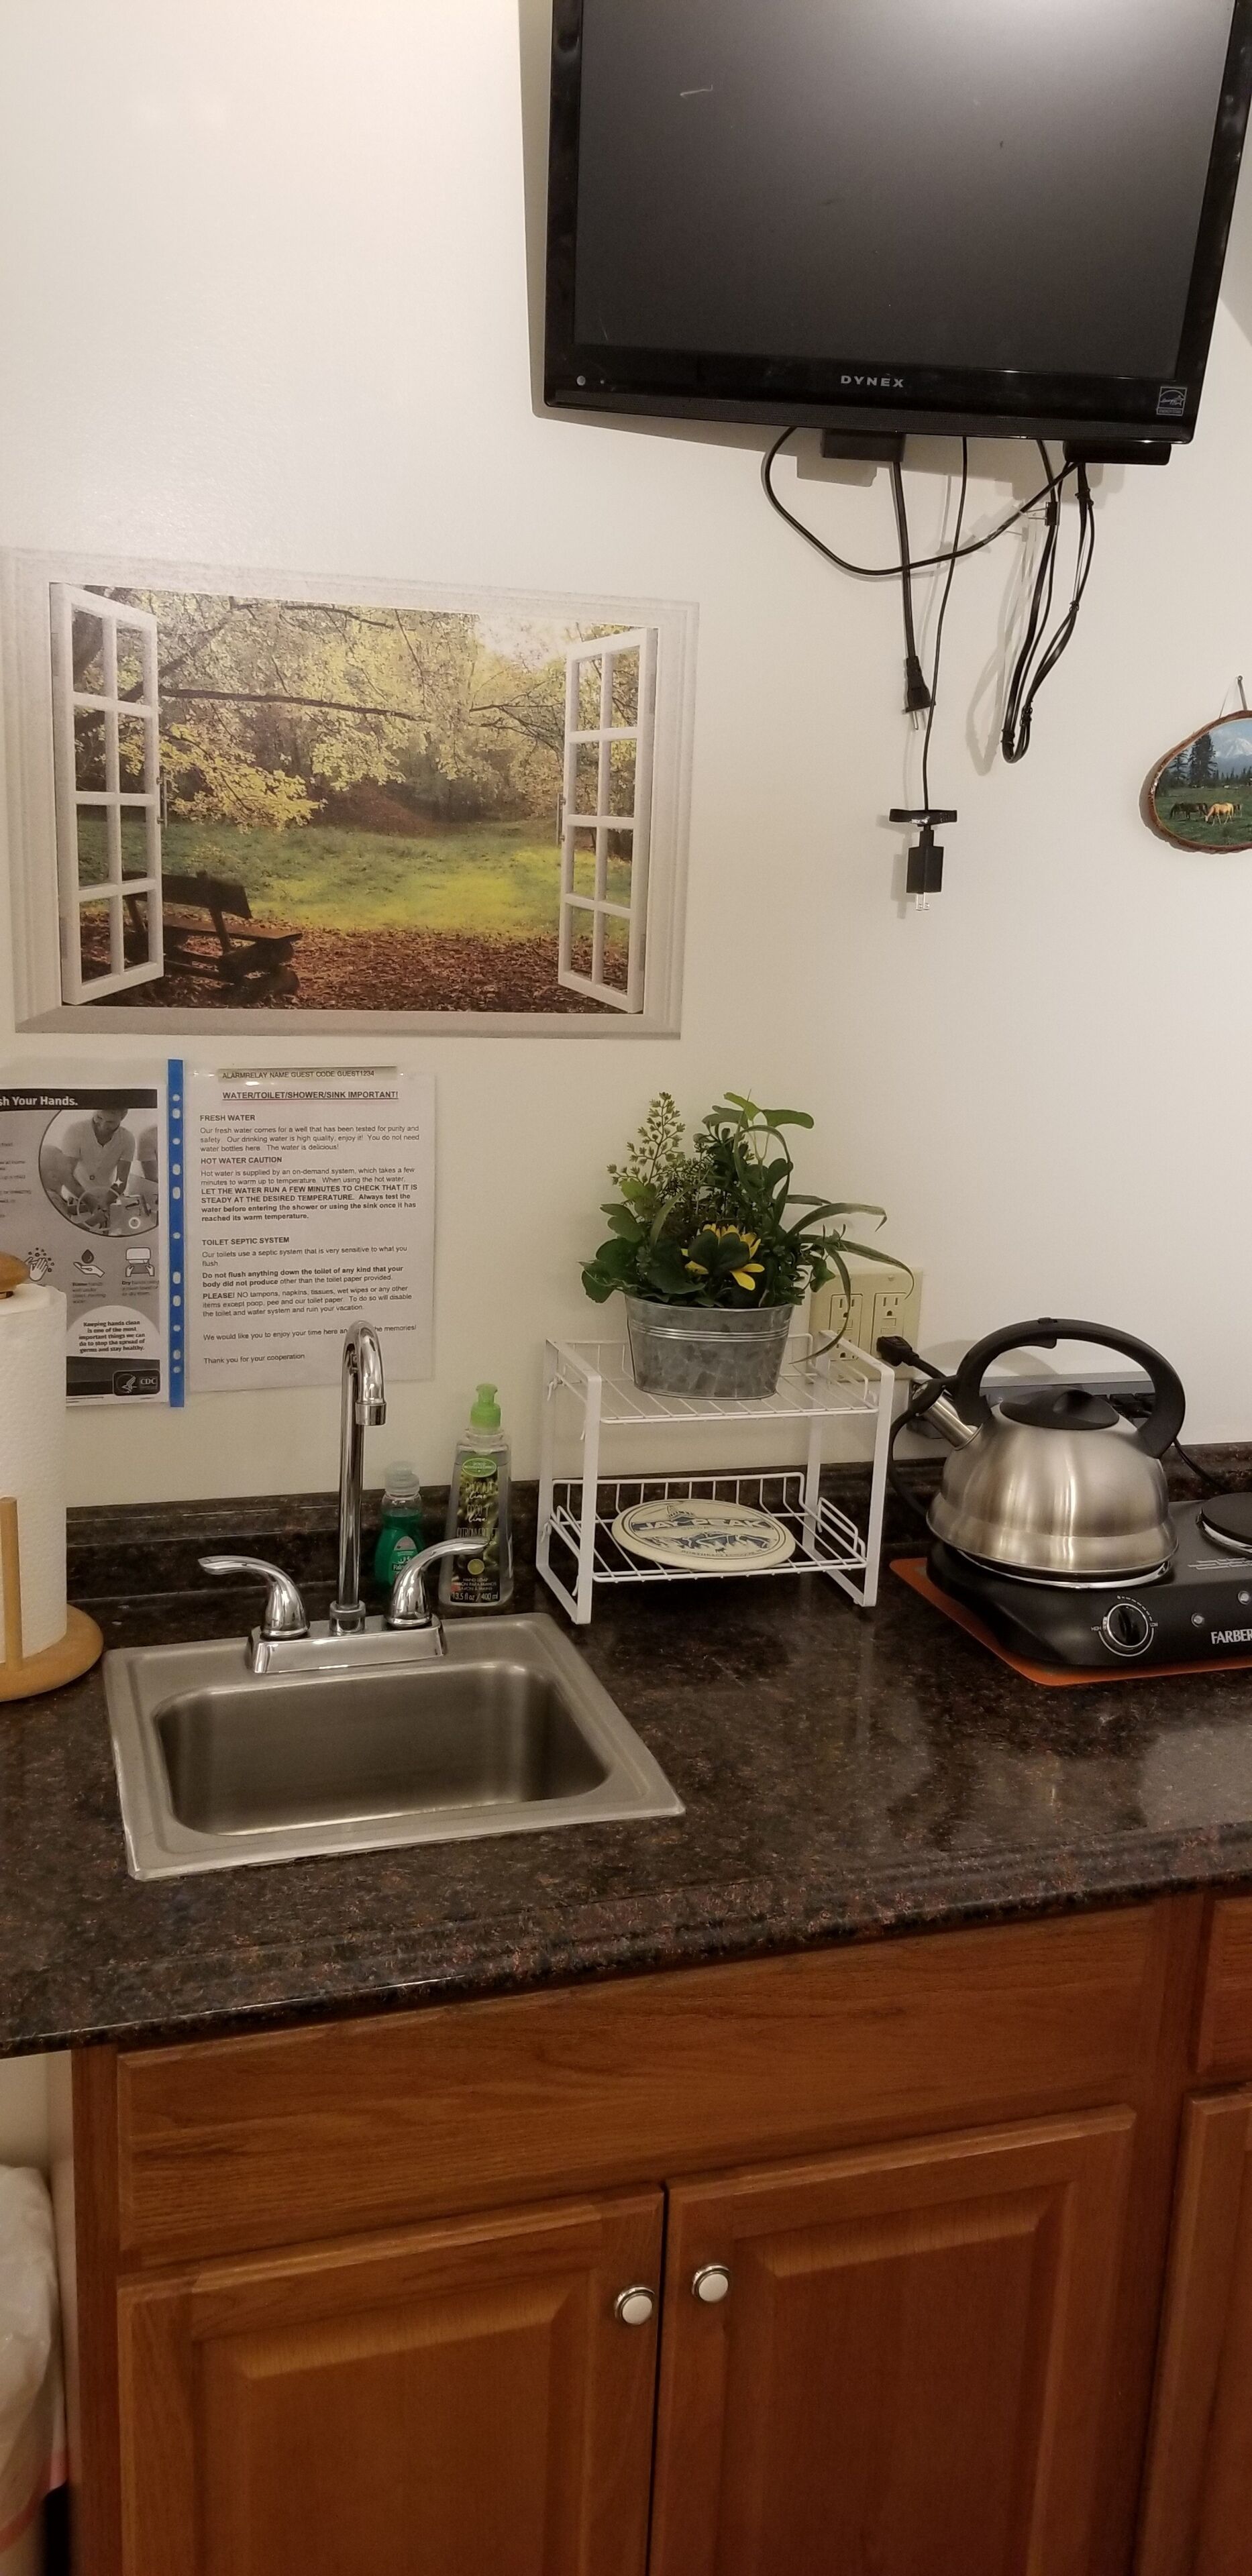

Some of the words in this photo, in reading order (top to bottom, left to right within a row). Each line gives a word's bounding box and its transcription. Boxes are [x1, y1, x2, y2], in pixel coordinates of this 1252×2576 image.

[841, 375, 904, 388] DYNEX
[222, 1092, 345, 1100] WATER/TOILET/SHOWER/SINK
[348, 1091, 398, 1100] IMPORTANT!
[12, 1096, 37, 1106] Your
[40, 1096, 78, 1106] Hands.
[247, 1270, 278, 1278] anything
[639, 1522, 679, 1530] JAY
[694, 1519, 764, 1528] PEAK
